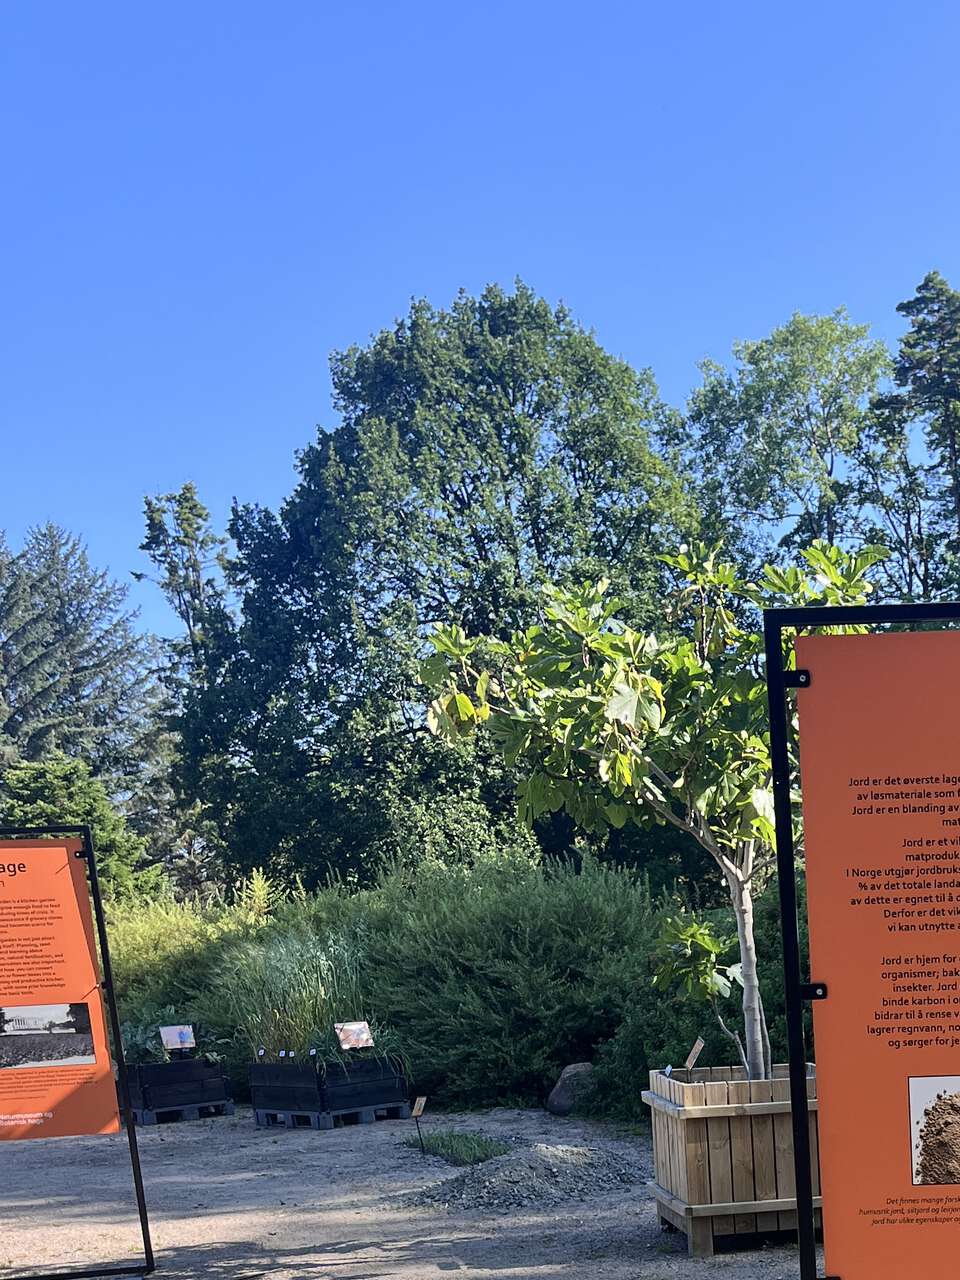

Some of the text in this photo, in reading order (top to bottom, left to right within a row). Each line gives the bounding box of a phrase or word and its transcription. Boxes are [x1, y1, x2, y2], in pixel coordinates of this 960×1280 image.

[848, 776, 870, 786] Jord
[884, 776, 901, 785] det
[902, 775, 940, 784] øverste
[870, 789, 932, 800] løsmateriale
[852, 804, 873, 815] Jord
[902, 803, 945, 815] blanding
[902, 837, 923, 847] Jord
[937, 837, 948, 846] et
[846, 868, 849, 877] I
[851, 868, 882, 879] Norge
[884, 866, 914, 878] utgjør
[858, 882, 868, 890] %
[883, 880, 900, 890] det
[901, 879, 931, 889] totale
